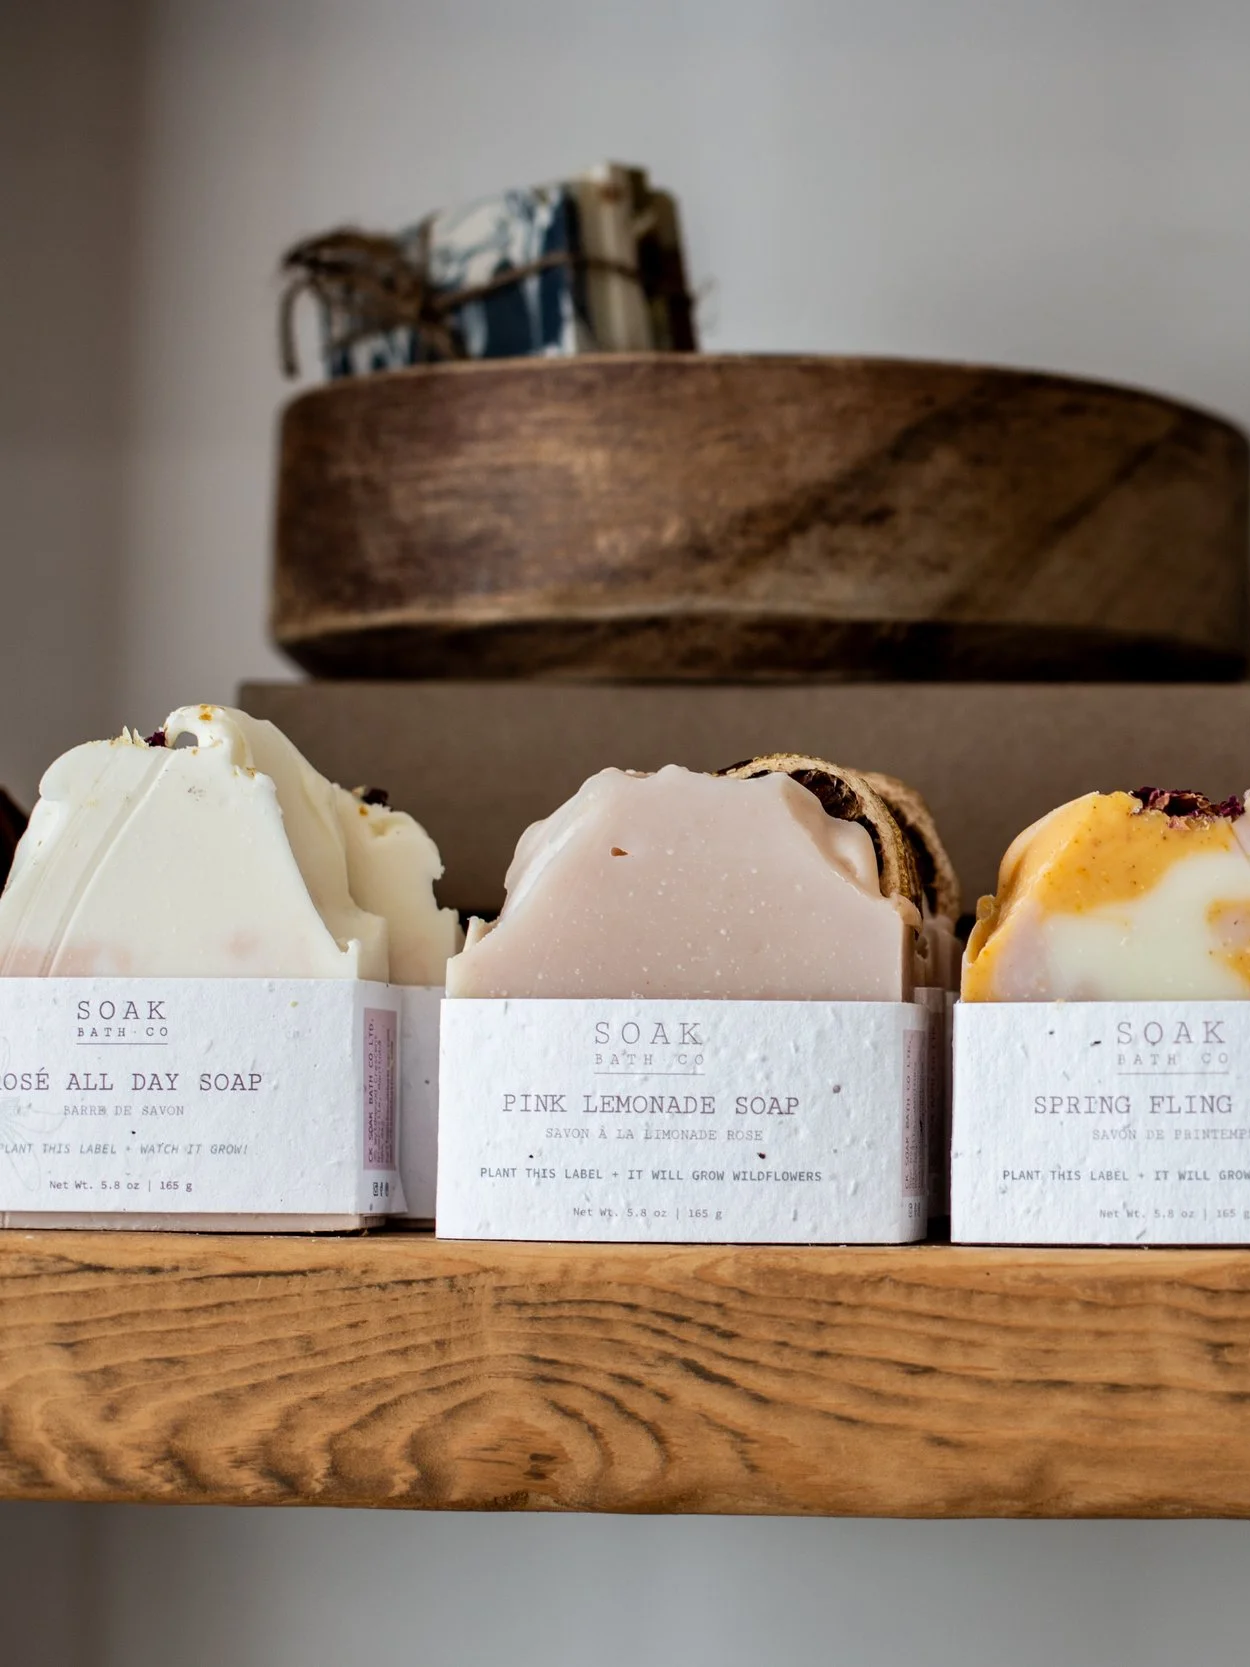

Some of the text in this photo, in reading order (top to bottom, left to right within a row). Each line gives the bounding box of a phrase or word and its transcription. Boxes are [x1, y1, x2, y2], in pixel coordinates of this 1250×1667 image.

[76, 1000, 167, 1020] SOAK
[77, 1026, 168, 1038] BATH CO
[594, 1022, 703, 1045] SOAK
[1117, 1021, 1226, 1045] SOAK
[595, 1053, 705, 1065] BATH CO
[1117, 1052, 1229, 1066] BATH CO
[0, 1066, 263, 1092] OSÉ ALL DAY SOAP
[63, 1105, 185, 1117] BARRE DE SAVON
[502, 1094, 800, 1116] PINK LEMONADE SOAP
[1034, 1095, 1131, 1115] SPRING
[1149, 1095, 1233, 1115] FLING
[546, 1128, 590, 1139] SAVON
[616, 1128, 635, 1140] LA
[644, 1129, 718, 1140] LIMONADE
[727, 1129, 764, 1141] ROSE
[1092, 1128, 1137, 1141] SAVON
[1146, 1128, 1165, 1141] DE
[42, 1143, 71, 1155] THIS
[79, 1143, 117, 1155] LABEL
[139, 1143, 179, 1155] WATCH
[185, 1143, 203, 1155] IT
[209, 1143, 248, 1155] GROW!
[480, 1167, 518, 1179] PLANT
[525, 1168, 556, 1179] THIS
[564, 1169, 603, 1180] LABEL
[628, 1169, 644, 1180] IT
[652, 1170, 684, 1181] WILL
[692, 1170, 725, 1182] GROW
[733, 1170, 822, 1182] WILDFLOWERS
[1003, 1170, 1041, 1182] PLANT
[1050, 1170, 1082, 1182] THIS
[1090, 1170, 1129, 1182] LABEL
[1154, 1170, 1170, 1182] IT
[1178, 1170, 1211, 1182] WILL
[49, 1180, 69, 1190] Net
[75, 1180, 93, 1190] Wt.
[100, 1180, 121, 1190] 5.8
[126, 1182, 140, 1190] oz
[159, 1180, 180, 1190] 165
[185, 1182, 193, 1192] g
[573, 1207, 593, 1217] Net
[599, 1207, 618, 1218] Wt.
[627, 1208, 647, 1218] 5.8
[654, 1210, 668, 1218] oz
[688, 1208, 709, 1218] 165
[715, 1211, 723, 1220] g
[1099, 1208, 1119, 1219] Net
[1126, 1208, 1146, 1219] Wt.
[1154, 1208, 1175, 1219] 5.8
[1181, 1210, 1195, 1219] oz
[1216, 1208, 1236, 1219] 165
[1243, 1210, 1250, 1221] g
